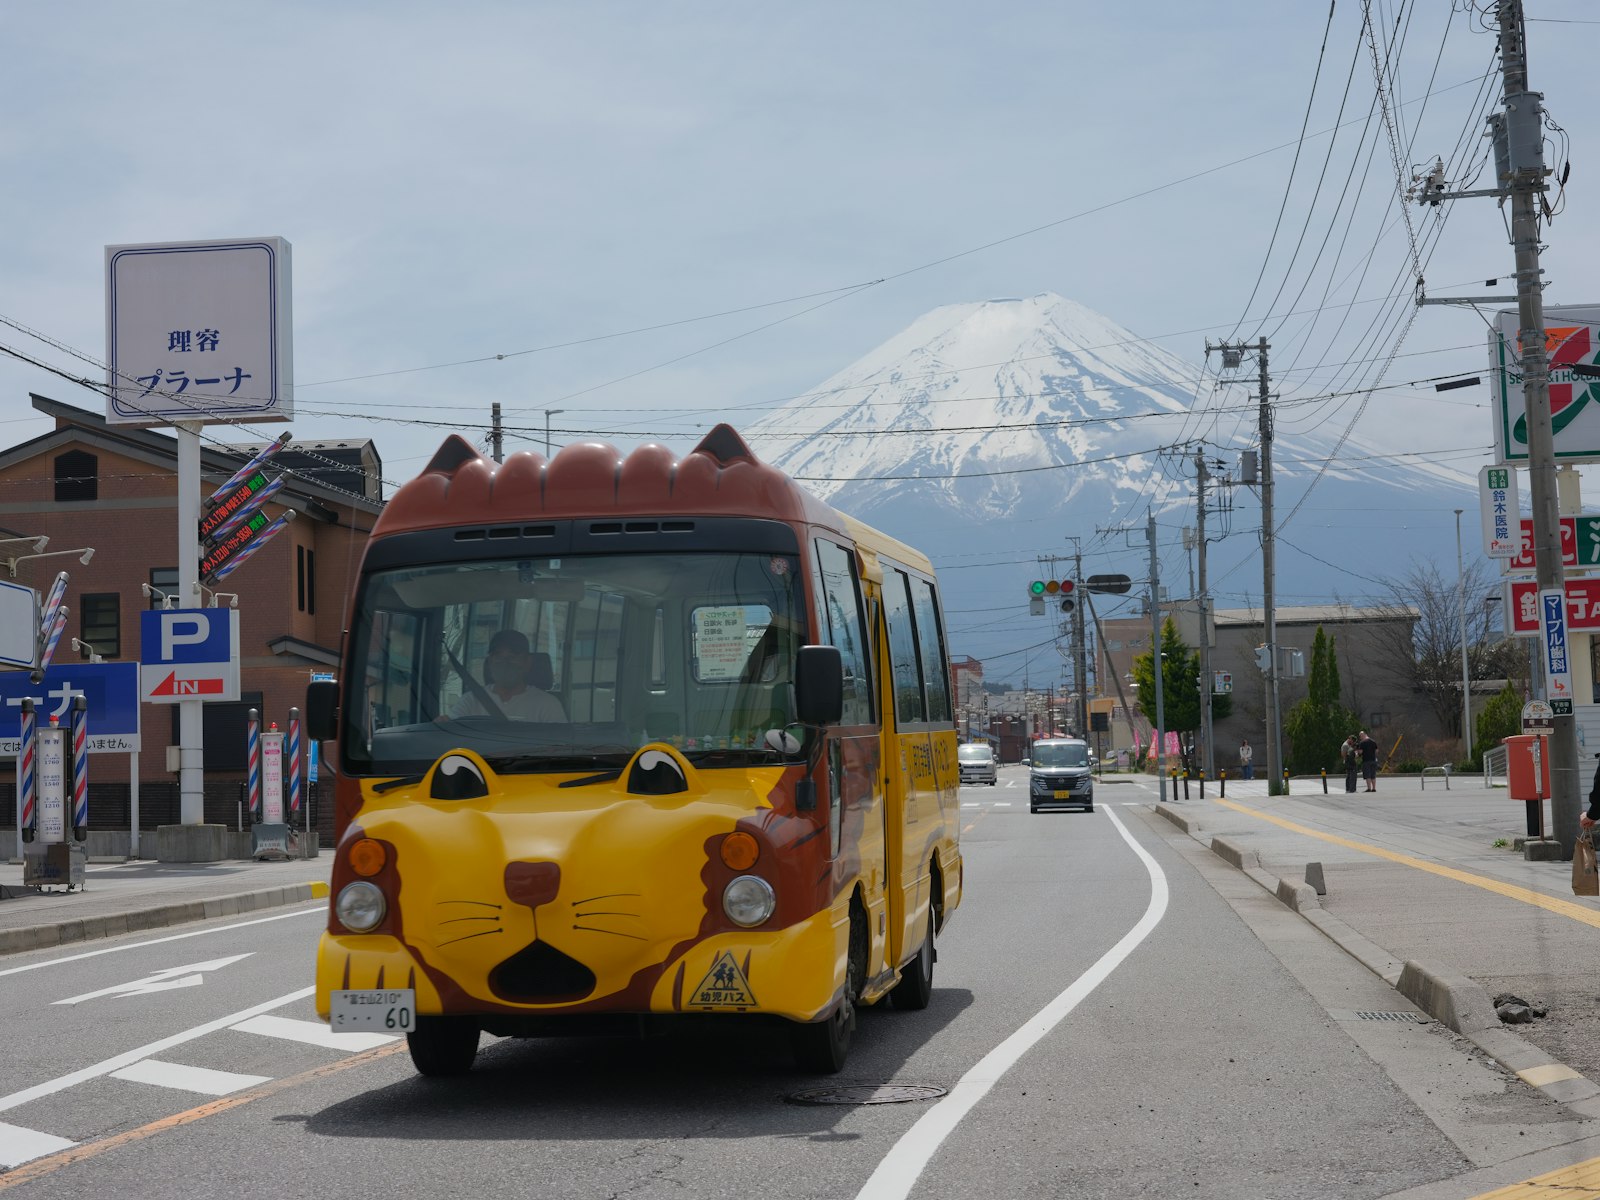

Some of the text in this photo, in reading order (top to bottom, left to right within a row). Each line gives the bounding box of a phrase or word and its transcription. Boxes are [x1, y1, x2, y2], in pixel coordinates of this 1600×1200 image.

[167, 328, 220, 353] 理容
[136, 366, 252, 399] プラーナ
[1493, 490, 1509, 539] 鈴木医院
[161, 612, 210, 660] P
[1546, 596, 1565, 672] マーブル歯科
[0, 681, 84, 717] ーナ
[173, 680, 199, 694] IN
[701, 991, 745, 1002] 幼児バス
